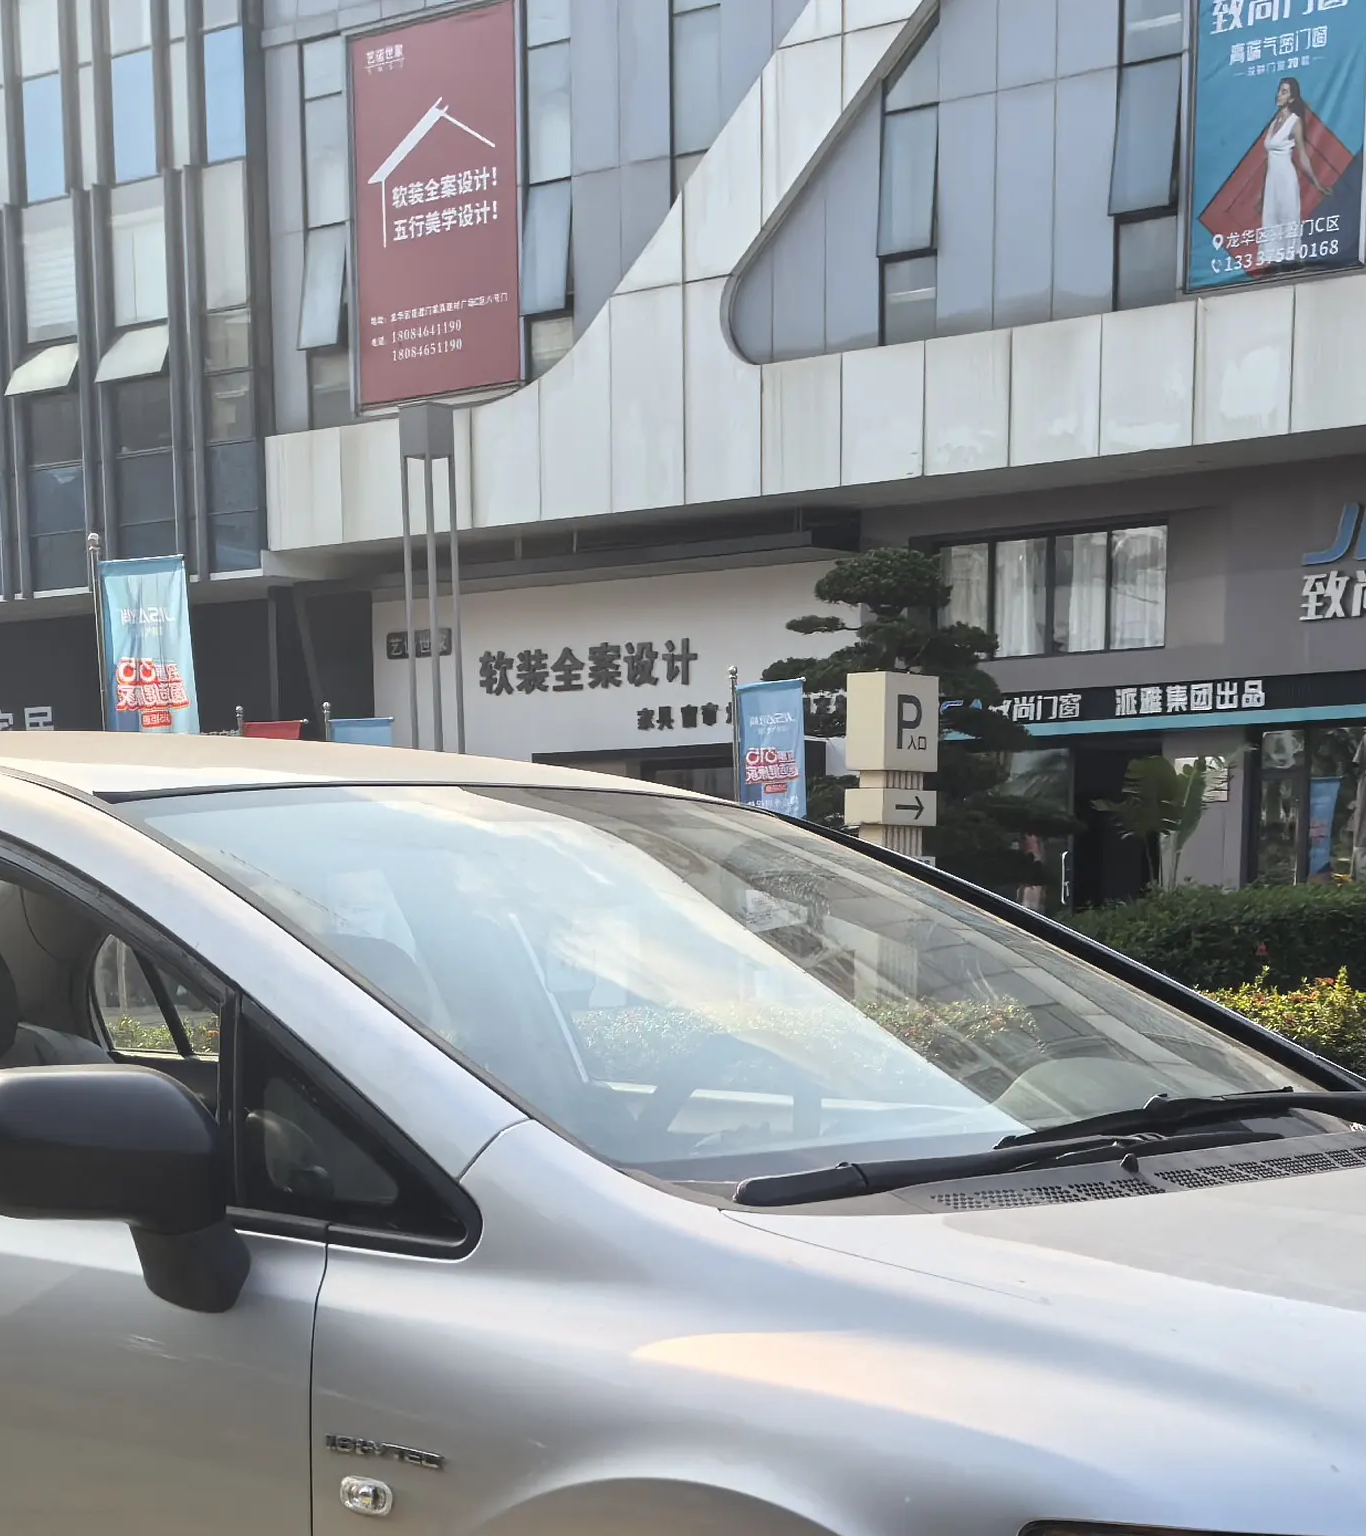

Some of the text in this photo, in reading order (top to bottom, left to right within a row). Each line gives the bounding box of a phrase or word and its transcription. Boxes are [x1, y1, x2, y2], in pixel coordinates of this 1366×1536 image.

[1299, 239, 1339, 259] 0168
[479, 637, 699, 696] 软装全案设计
[1115, 679, 1266, 716] 派雅集团出品
[897, 693, 922, 750] P
[907, 735, 927, 750] 入口
